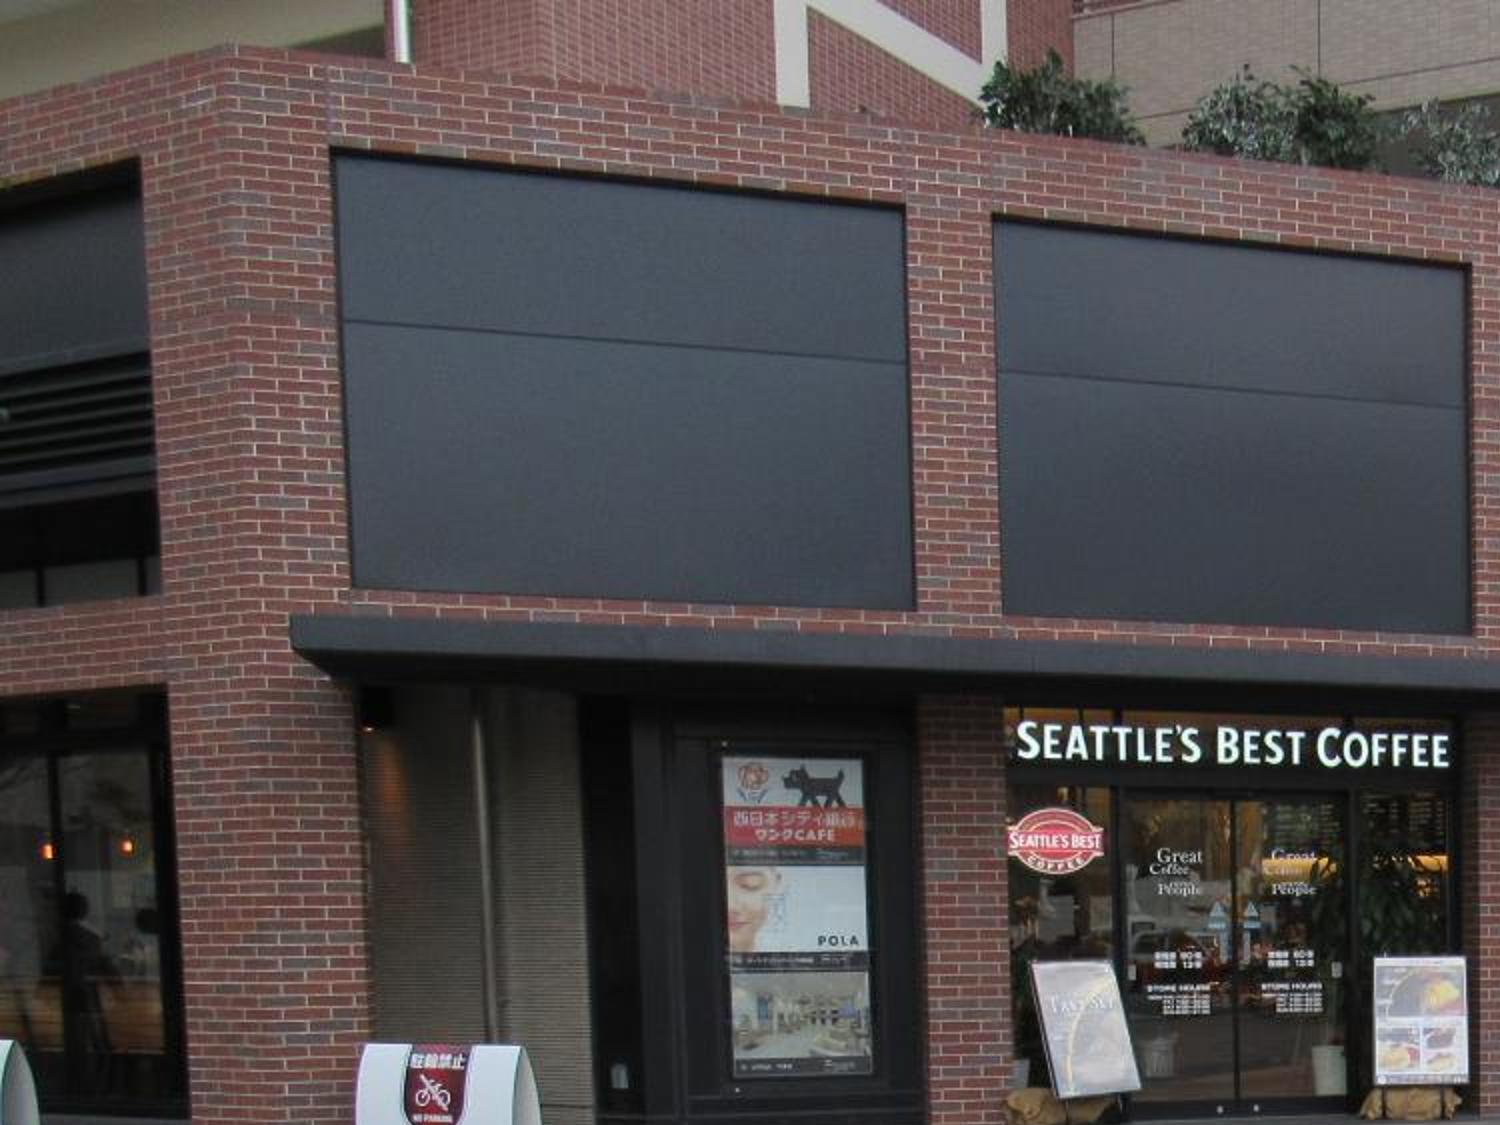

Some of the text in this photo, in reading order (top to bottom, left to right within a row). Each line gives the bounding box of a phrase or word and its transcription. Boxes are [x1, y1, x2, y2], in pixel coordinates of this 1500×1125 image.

[1017, 720, 1450, 768] SEATTLE'S BEST COFFEE
[1071, 834, 1100, 849] BEST
[1157, 847, 1202, 864] Great
[817, 935, 859, 946] POLA
